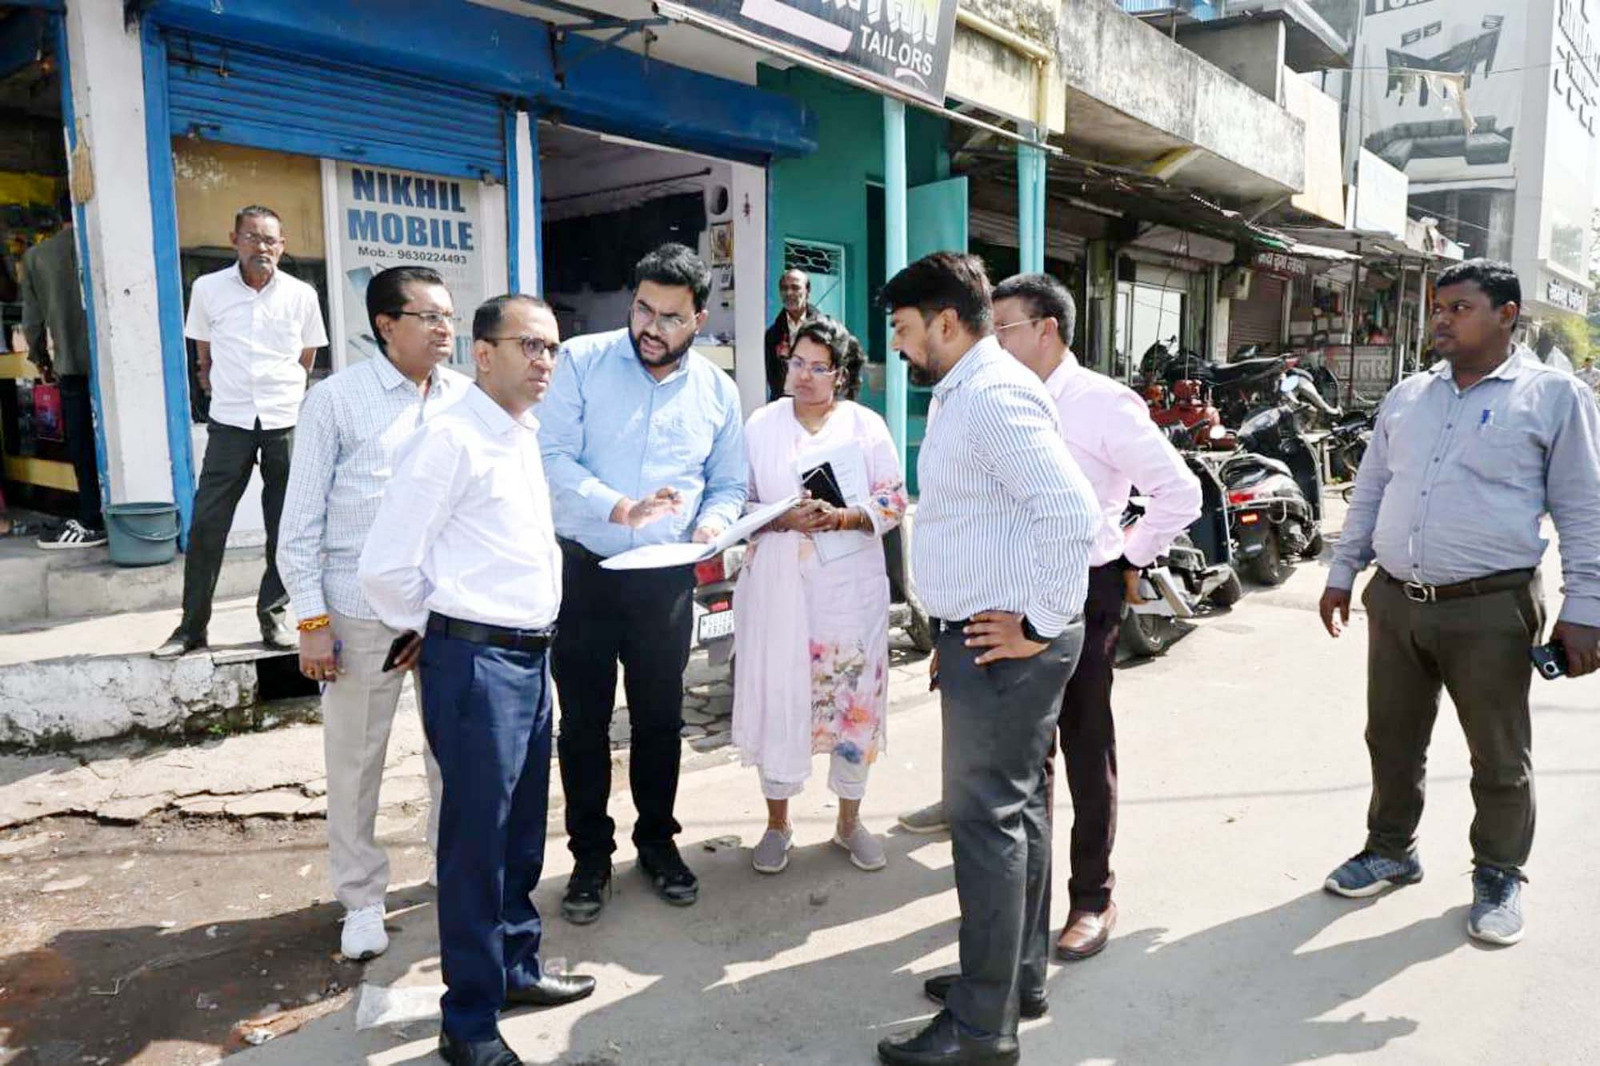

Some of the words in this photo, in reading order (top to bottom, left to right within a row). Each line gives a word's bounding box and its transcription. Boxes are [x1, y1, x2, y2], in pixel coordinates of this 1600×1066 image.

[860, 26, 933, 76] TAILORS
[351, 168, 466, 213] NIKHIL
[347, 209, 474, 251] MOBILE
[397, 250, 467, 265] 9630224493
